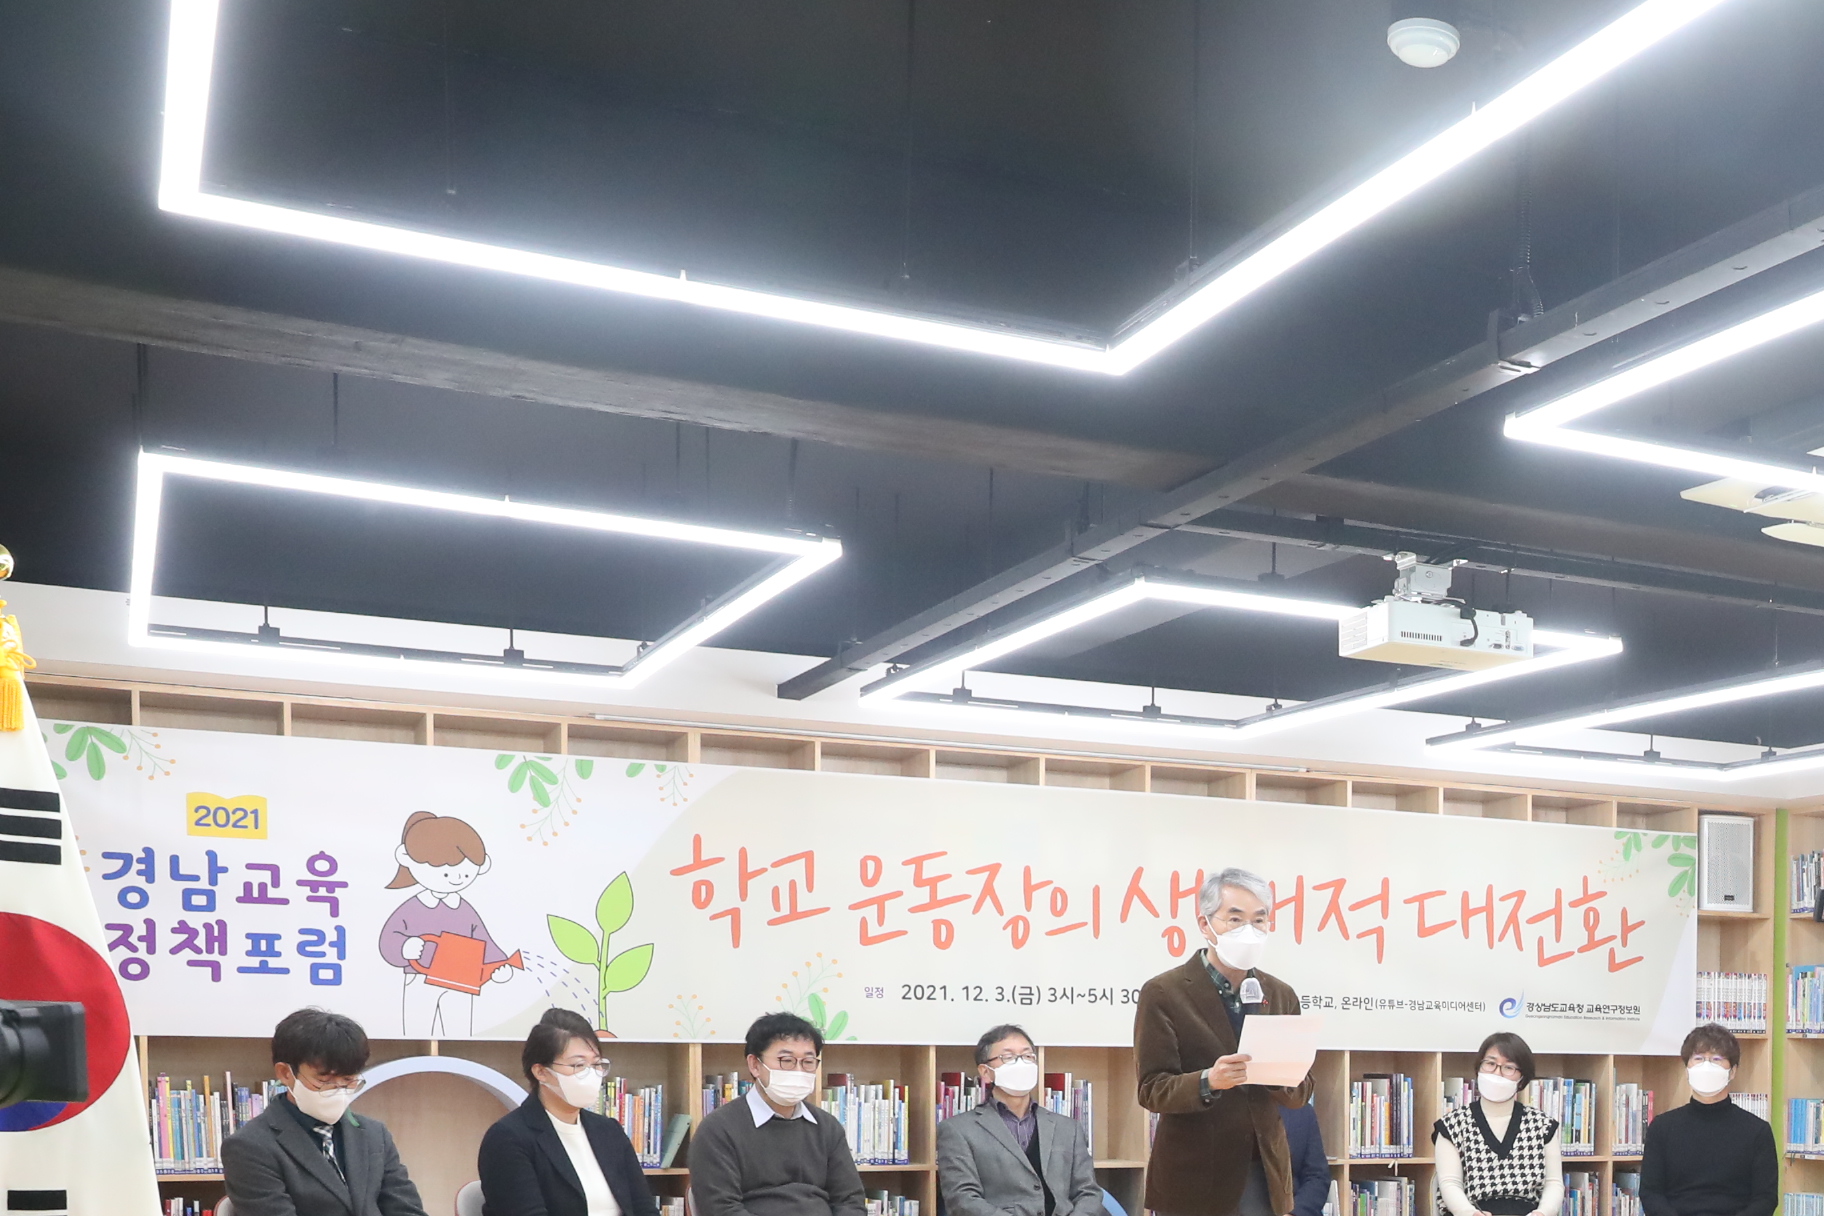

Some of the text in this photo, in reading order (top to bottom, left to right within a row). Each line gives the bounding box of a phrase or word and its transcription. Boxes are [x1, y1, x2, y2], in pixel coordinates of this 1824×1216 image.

[193, 805, 260, 830] 2021
[101, 846, 349, 918] 경남교육
[669, 833, 831, 949] 학교
[848, 850, 1100, 950] 운동장의
[1402, 875, 1646, 973] 대전환
[104, 917, 347, 986] 정책포럼
[864, 986, 885, 999] 일정
[901, 984, 955, 1002] 2021.
[961, 985, 989, 1003] 12.
[994, 984, 1041, 1006] 3.(금)
[1047, 986, 1114, 1006] 3시~5시
[1526, 1002, 1641, 1015] 경상남도교육청 교육연구정보원
